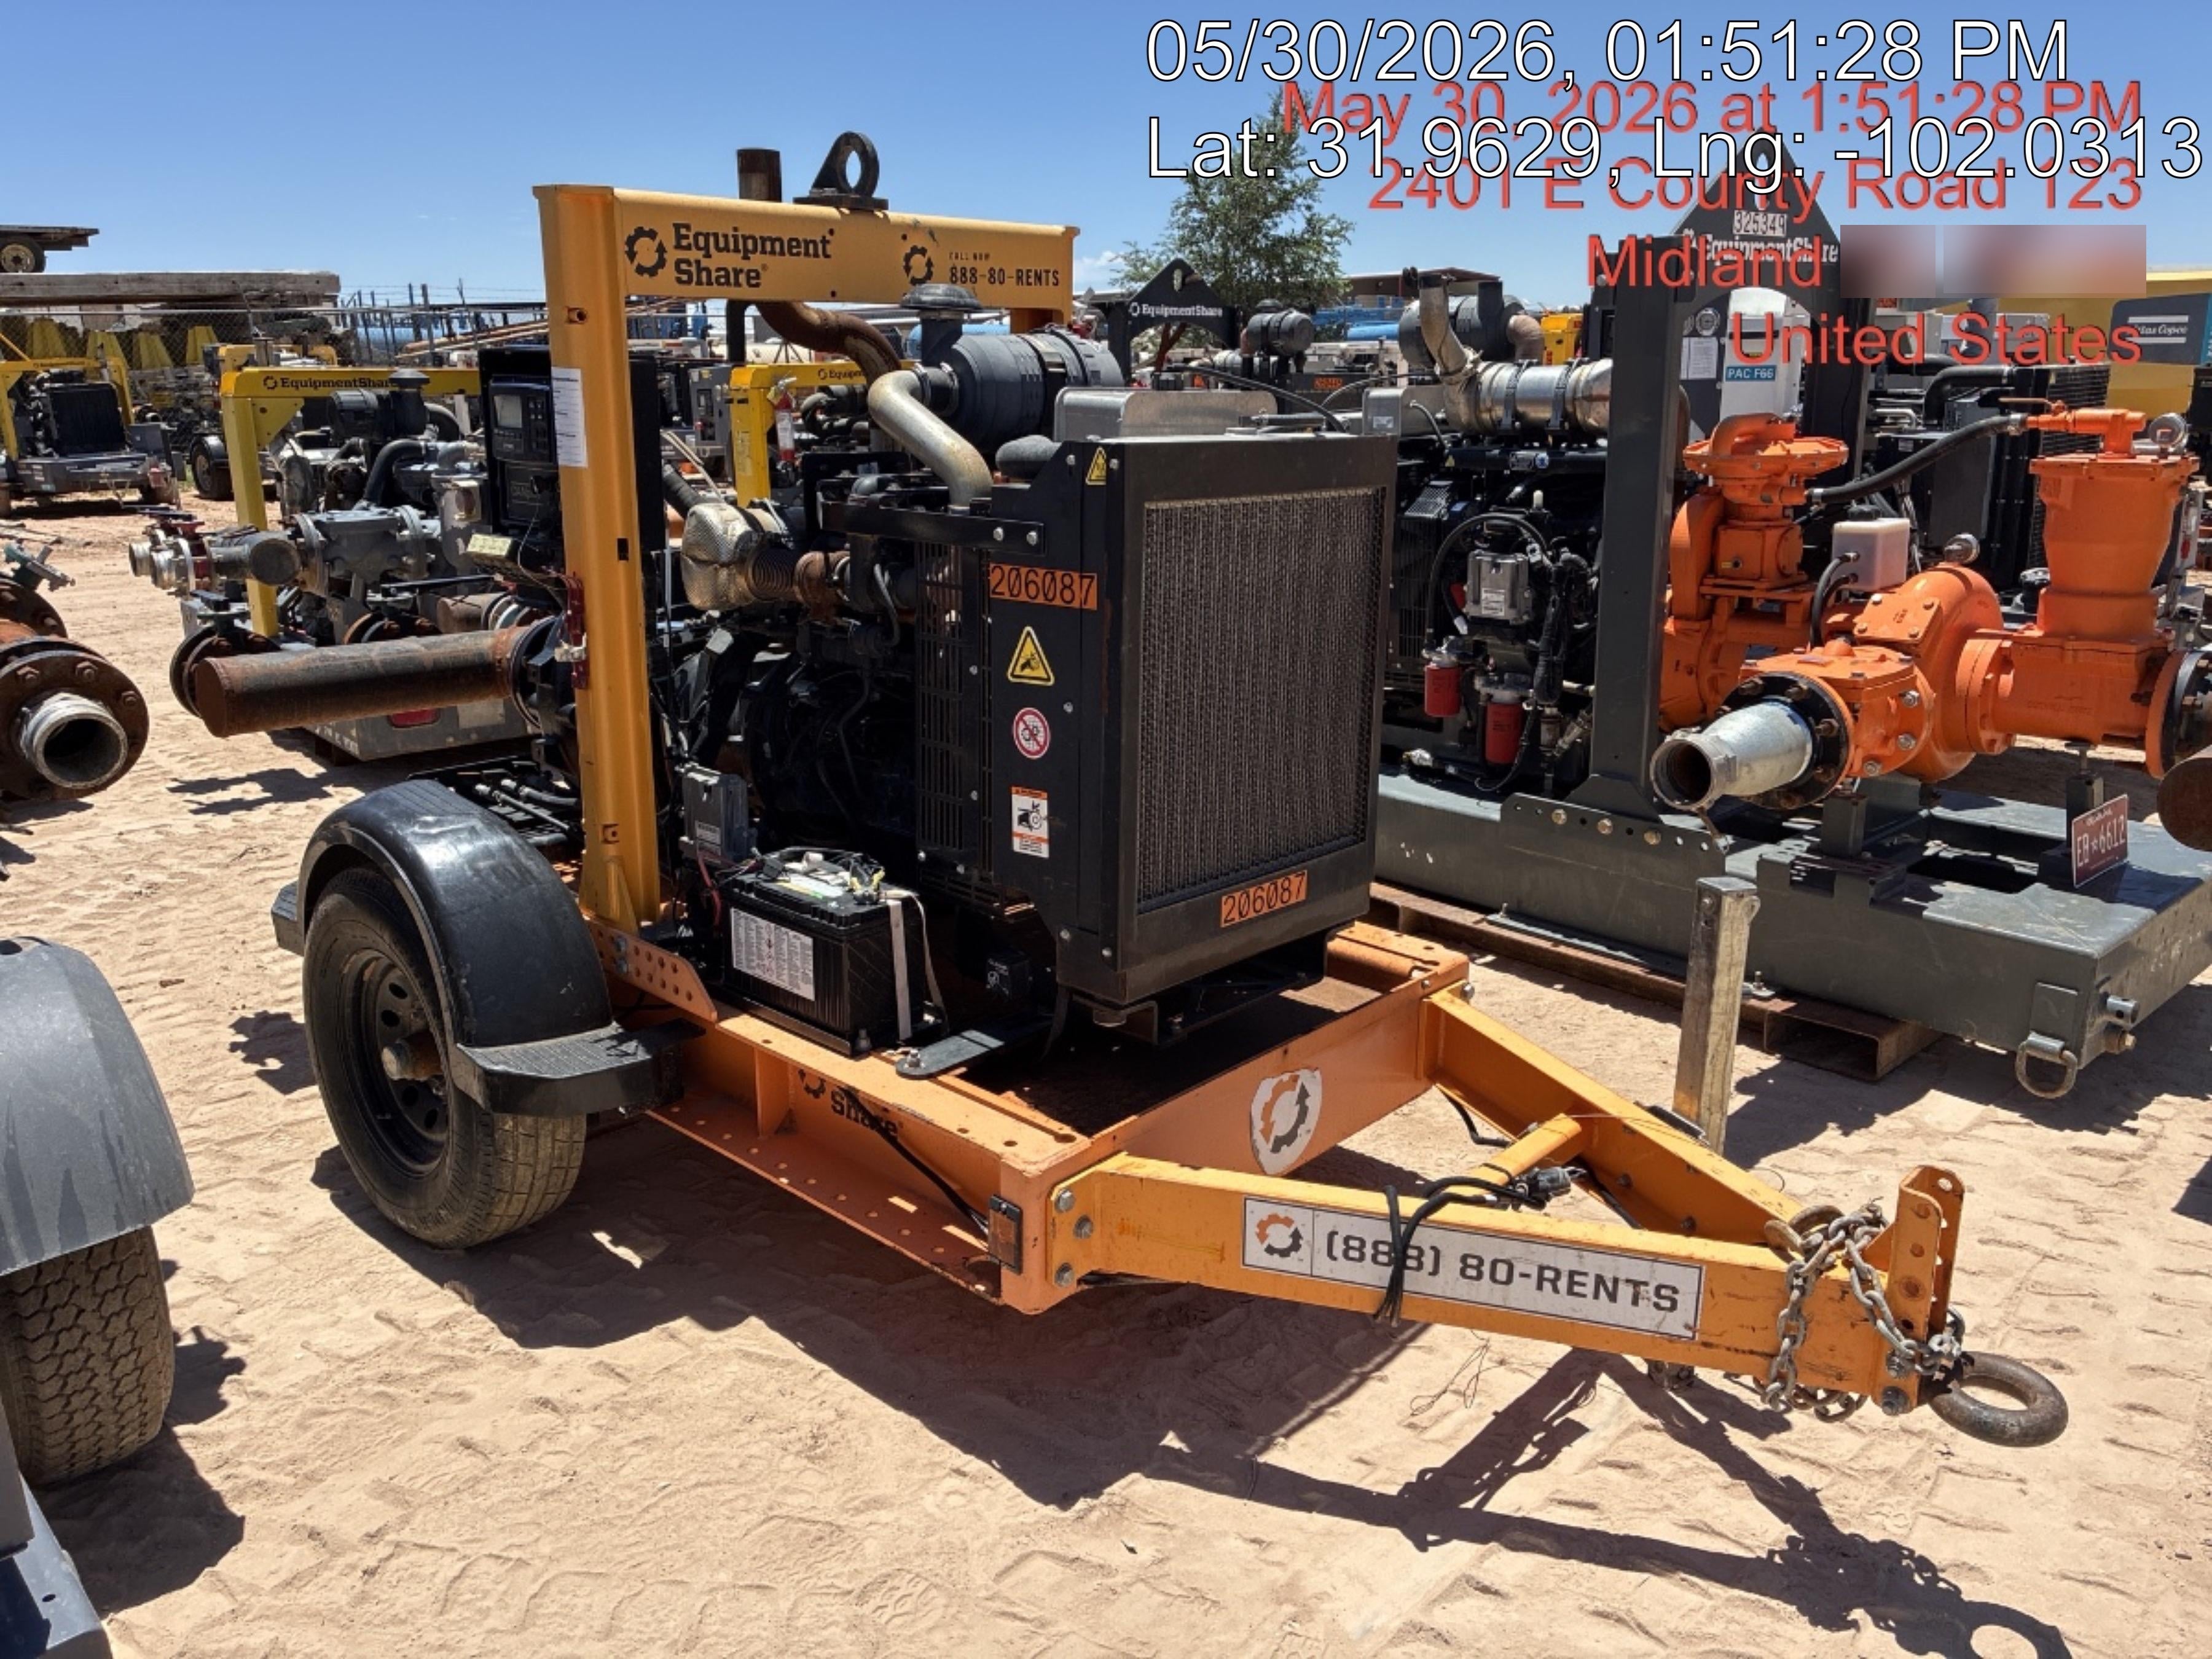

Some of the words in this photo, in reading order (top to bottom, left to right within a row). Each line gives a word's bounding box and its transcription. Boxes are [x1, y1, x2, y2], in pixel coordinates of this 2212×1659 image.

[1734, 211, 1786, 235] 325349
[672, 222, 832, 261] Equipment
[1704, 233, 1839, 266] EquipmentShre
[949, 267, 1060, 286] 888-80-RENTS
[2133, 324, 2156, 335] tlas
[1728, 368, 1751, 379] PAC
[991, 565, 1096, 606] 206087
[1223, 871, 1306, 924] 206087
[1326, 1230, 1441, 1277] (888)
[1459, 1253, 1681, 1314] 80-RENTS
